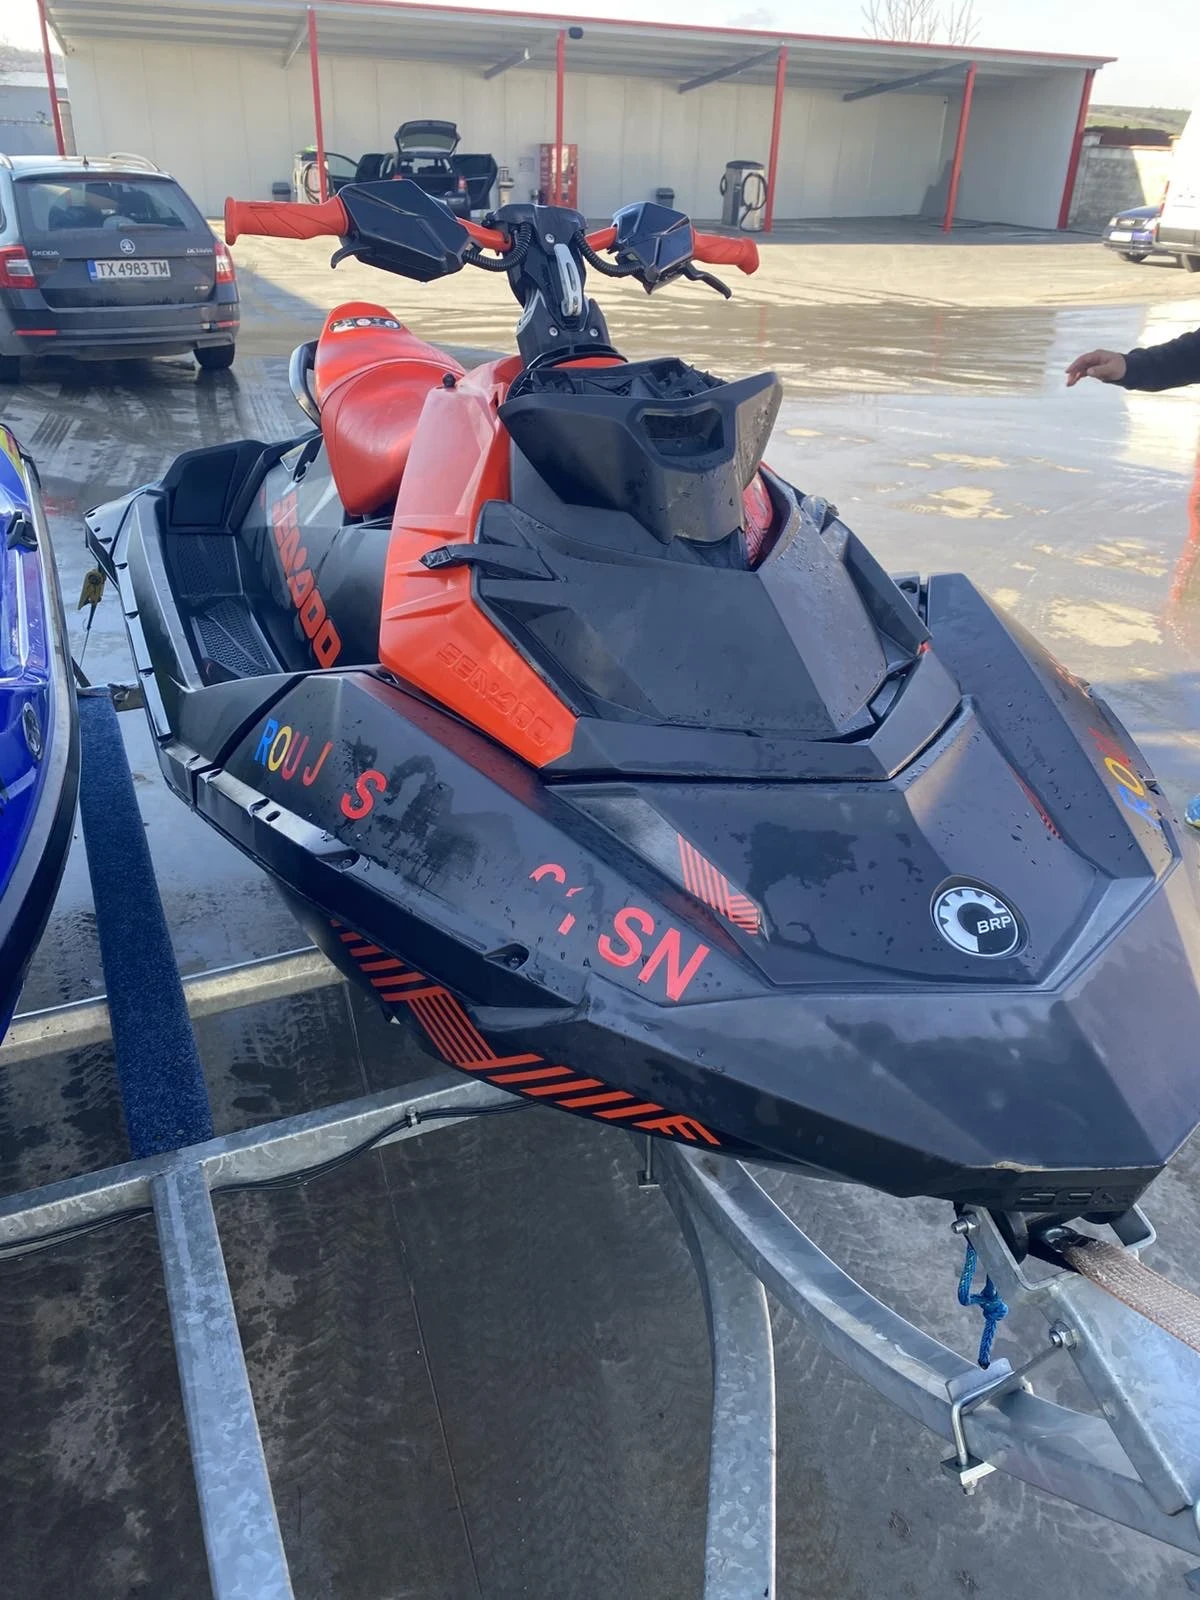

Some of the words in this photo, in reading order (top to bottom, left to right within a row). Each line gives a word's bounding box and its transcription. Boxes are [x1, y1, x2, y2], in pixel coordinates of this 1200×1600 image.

[97, 262, 116, 276] TX
[118, 262, 149, 276] 4983
[976, 915, 1012, 934] BRP
[597, 906, 711, 1002] SN
